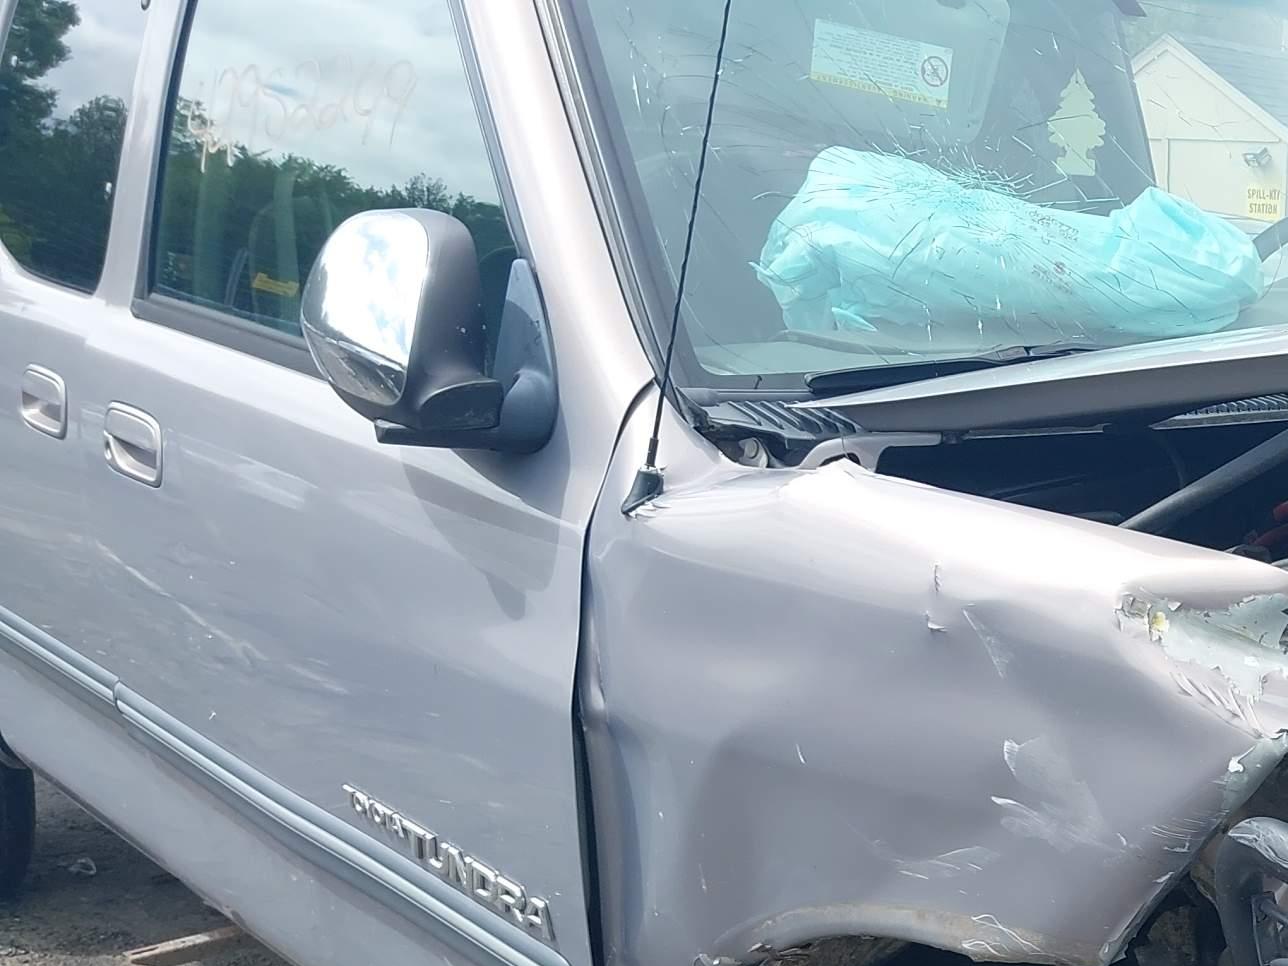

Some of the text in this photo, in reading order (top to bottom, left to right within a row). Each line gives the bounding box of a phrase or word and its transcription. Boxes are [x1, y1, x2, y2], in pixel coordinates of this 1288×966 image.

[1248, 202, 1278, 215] STATION
[342, 784, 558, 942] TOYOTA TUNDRA
